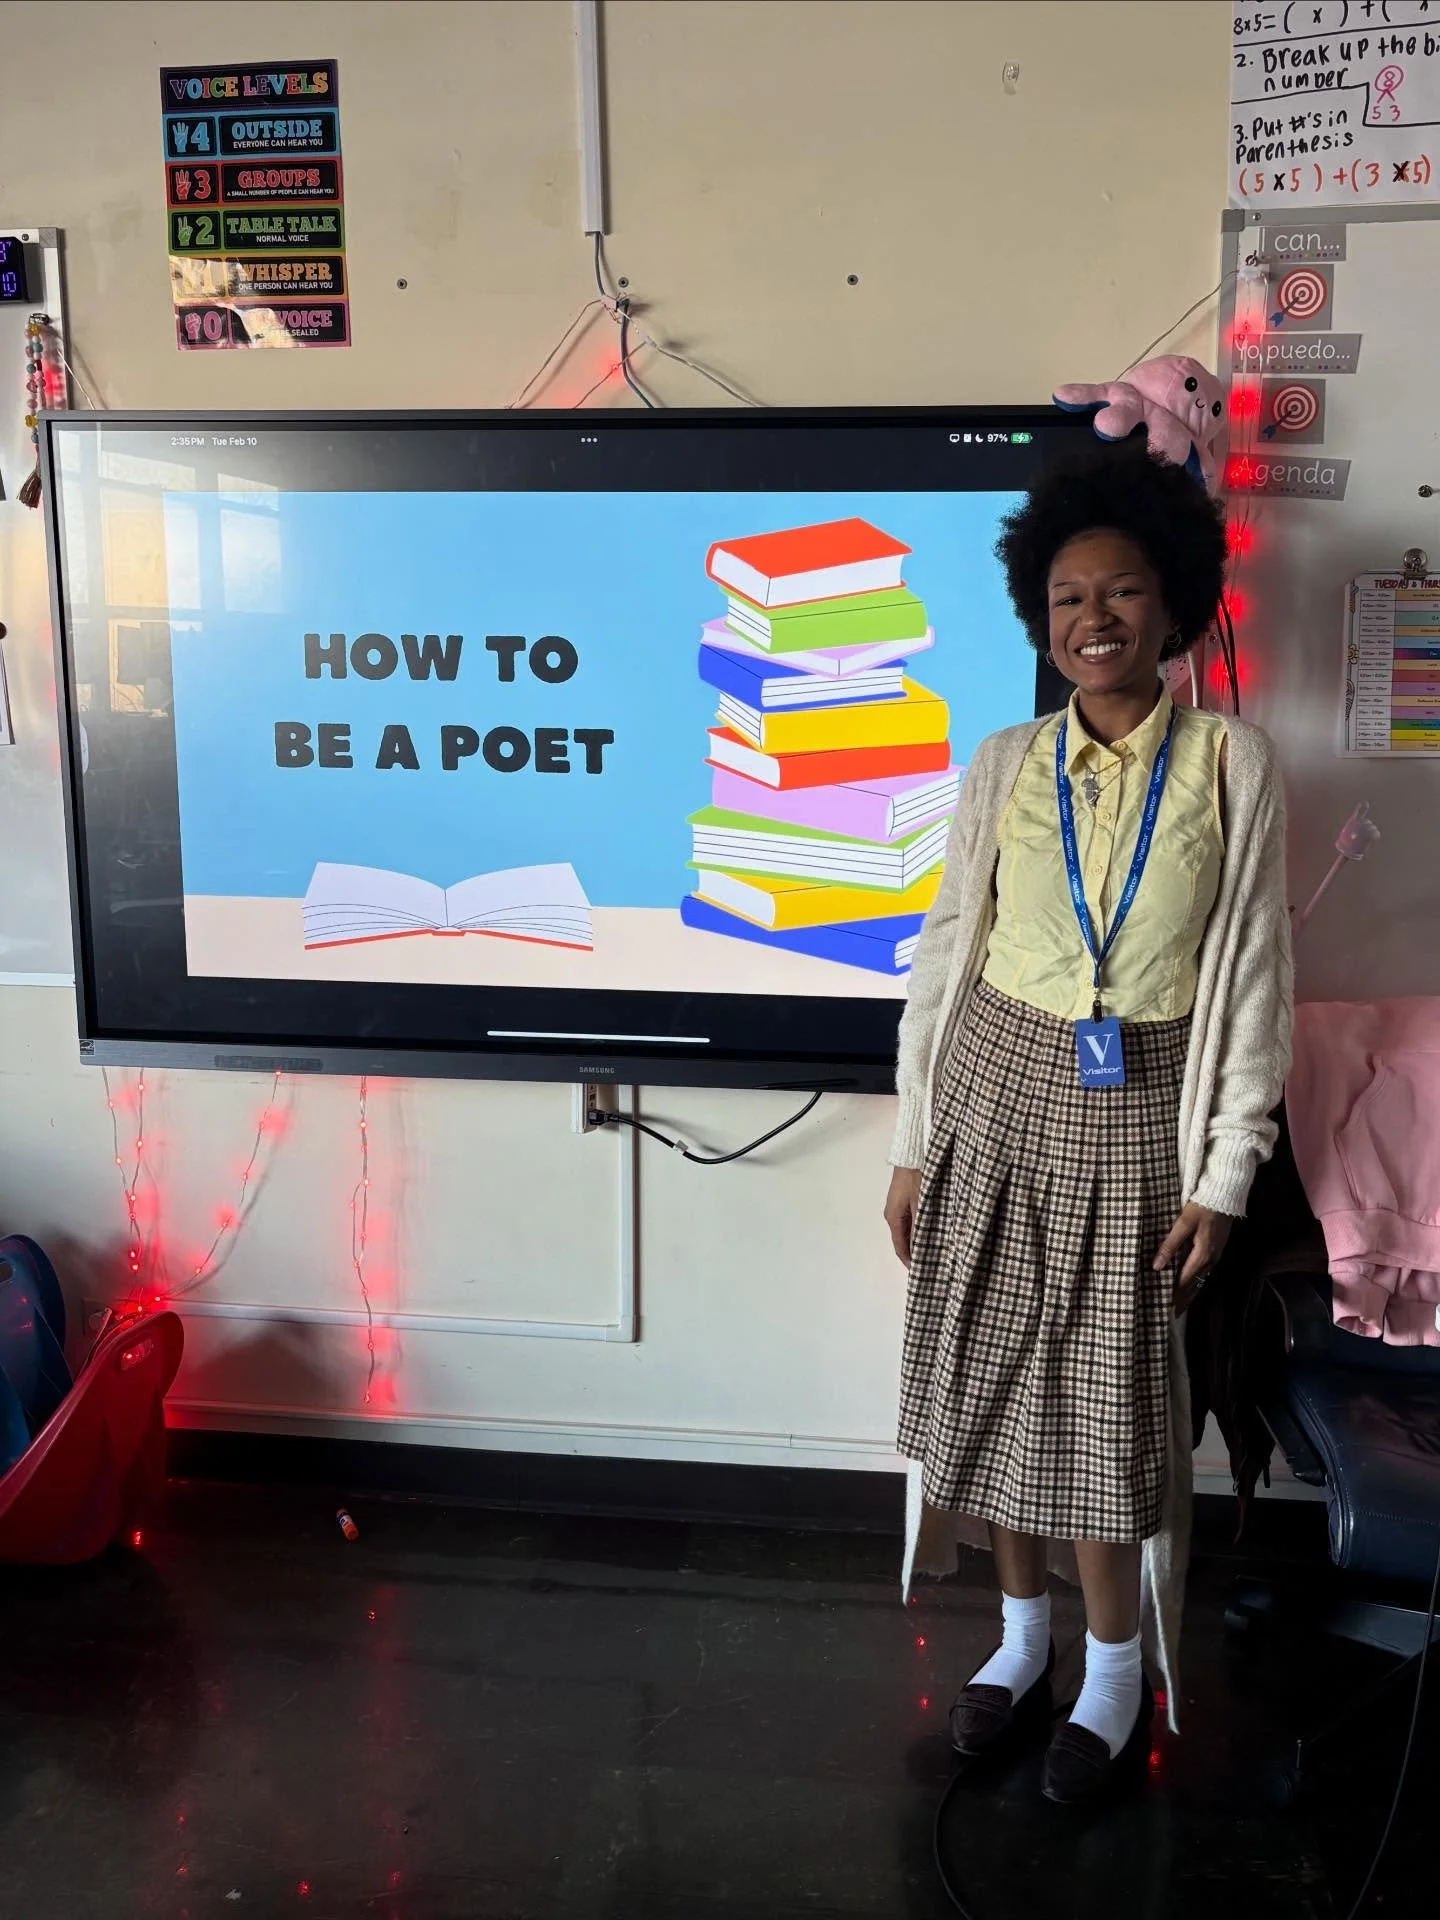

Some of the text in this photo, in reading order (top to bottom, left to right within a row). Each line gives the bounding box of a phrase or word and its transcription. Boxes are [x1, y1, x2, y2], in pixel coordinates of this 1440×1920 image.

[1234, 54, 1254, 68] 2.
[1262, 45, 1330, 74] Break
[1340, 38, 1369, 62] up
[1378, 34, 1417, 58] the
[170, 72, 329, 99] VOICE LEVELS
[1264, 68, 1349, 92] number
[1234, 124, 1249, 144] 3.
[1252, 117, 1284, 141] Put
[1328, 110, 1348, 127] in
[1372, 104, 1401, 122] 5 3
[191, 122, 210, 151] 4
[232, 120, 322, 140] OUTSIDE
[233, 138, 323, 149] EVERYONE CAN HEAR YOU
[194, 169, 211, 199] 3
[238, 168, 320, 189] GROUPS
[195, 215, 215, 245] 2
[226, 216, 337, 234] TABLE TALK
[256, 234, 309, 243] NORMAL VOICE
[238, 263, 333, 282] WHISPER
[254, 282, 282, 290] PERSON
[299, 281, 318, 289] HEAR
[319, 281, 333, 289] YOU
[203, 310, 223, 341] 0
[274, 310, 333, 328] VOICE
[211, 437, 227, 446] Tue
[229, 437, 245, 446] Feb
[246, 437, 257, 446] 10
[987, 433, 1008, 443] 97%
[1238, 456, 1336, 487] Agenda
[304, 633, 579, 684] HOW TO
[274, 721, 615, 774] BE A POET
[1154, 754, 1165, 784] Visitor
[1061, 795, 1069, 822] Visitor
[1146, 793, 1158, 822] Visitor
[1065, 833, 1075, 862] Visitor
[1137, 832, 1149, 862] Visitor
[1071, 873, 1082, 905] Visitor
[1123, 873, 1138, 905] Visitor
[1083, 1033, 1115, 1066] V
[579, 1066, 615, 1074] SAMSUNG
[1082, 1067, 1121, 1076] Visitor
